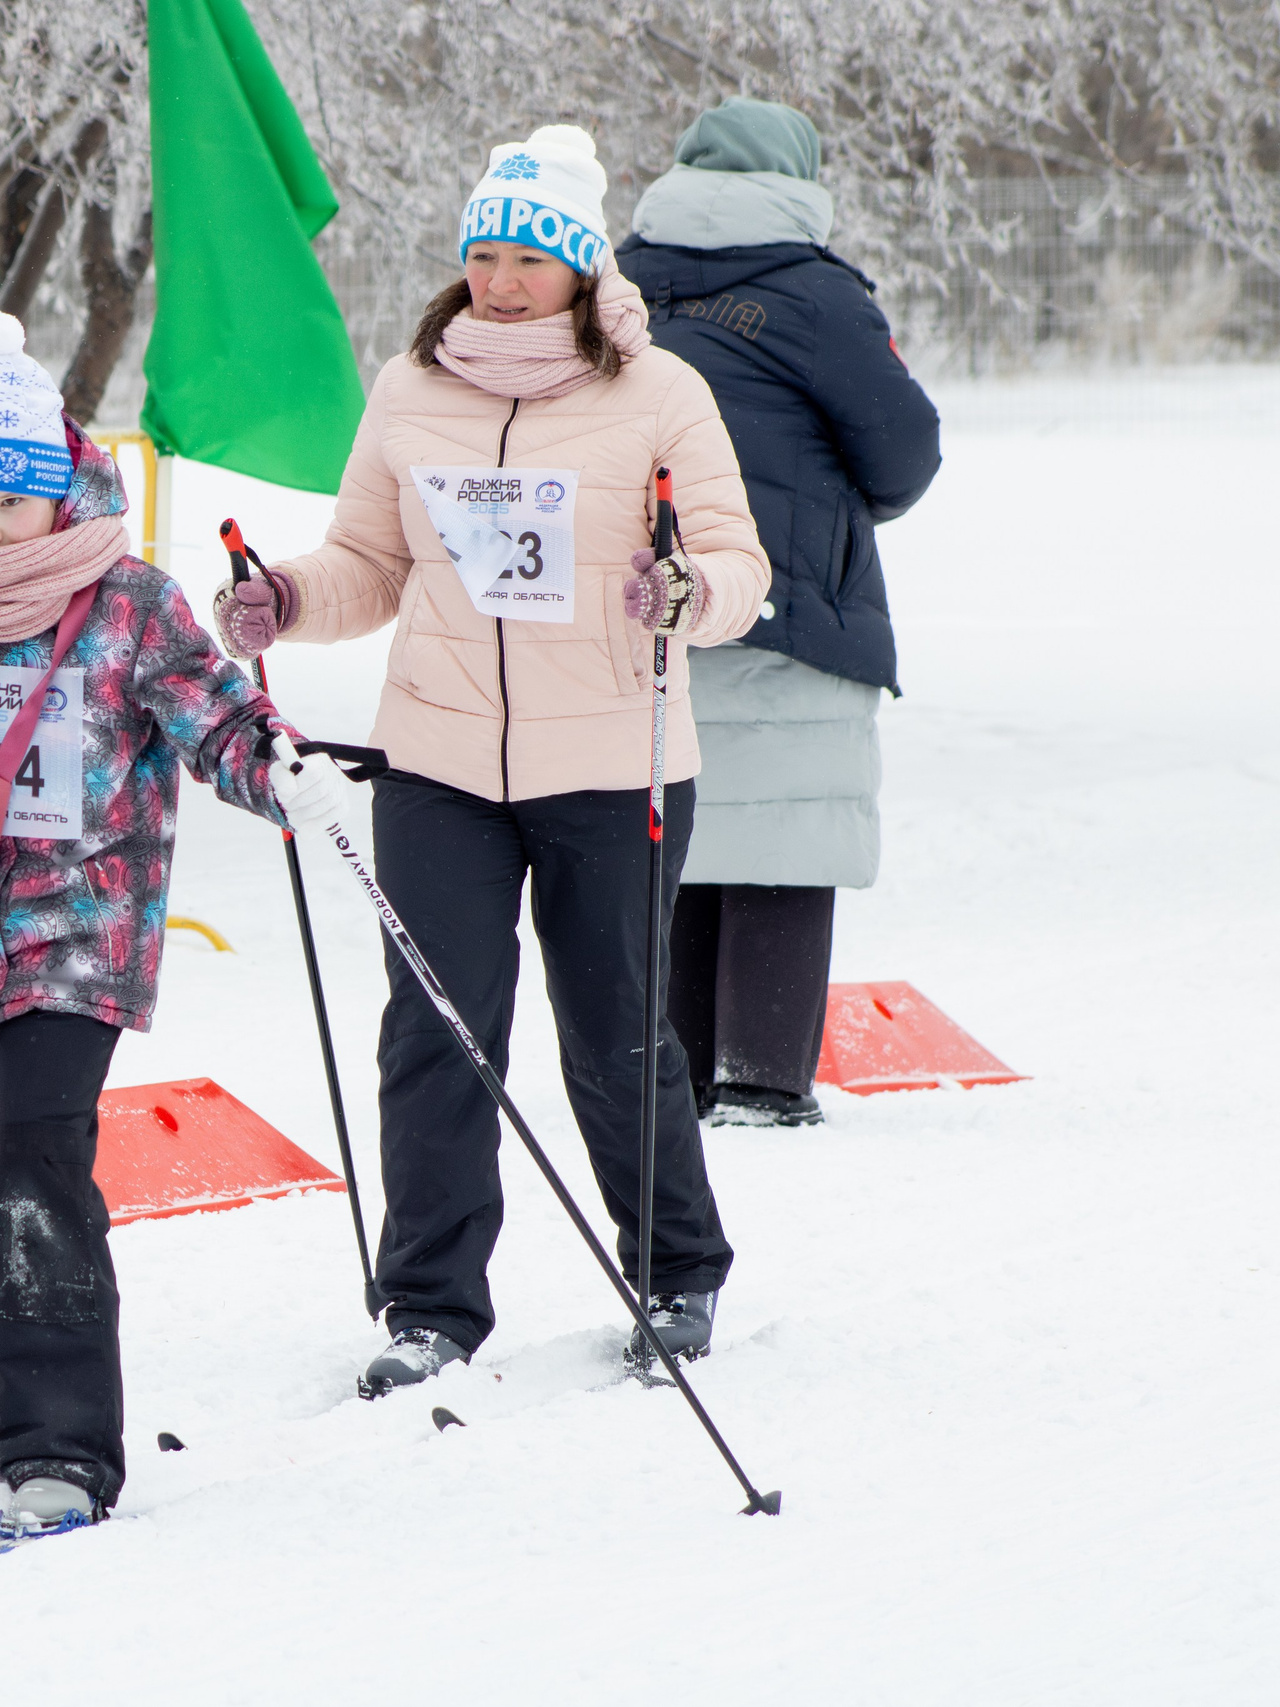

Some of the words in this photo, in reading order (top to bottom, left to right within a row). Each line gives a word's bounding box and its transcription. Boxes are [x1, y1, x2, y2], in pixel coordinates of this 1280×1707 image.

[463, 198, 505, 240] НЯ
[30, 459, 71, 474] МИНСПОРТ
[35, 471, 67, 483] РОССИИ
[460, 478, 522, 491] ЛЫЖНЯ
[457, 490, 523, 503] РОССИИ
[468, 502, 510, 515] 2025
[497, 530, 544, 581] 3
[481, 590, 508, 600] КАЯ
[513, 592, 565, 602] ОБЛАСТЬ
[13, 811, 69, 824] ОБЛАСТЬ
[350, 861, 400, 929] NORDWAY
[454, 1023, 475, 1049] ACTIVE
[472, 1049, 487, 1066] XC
